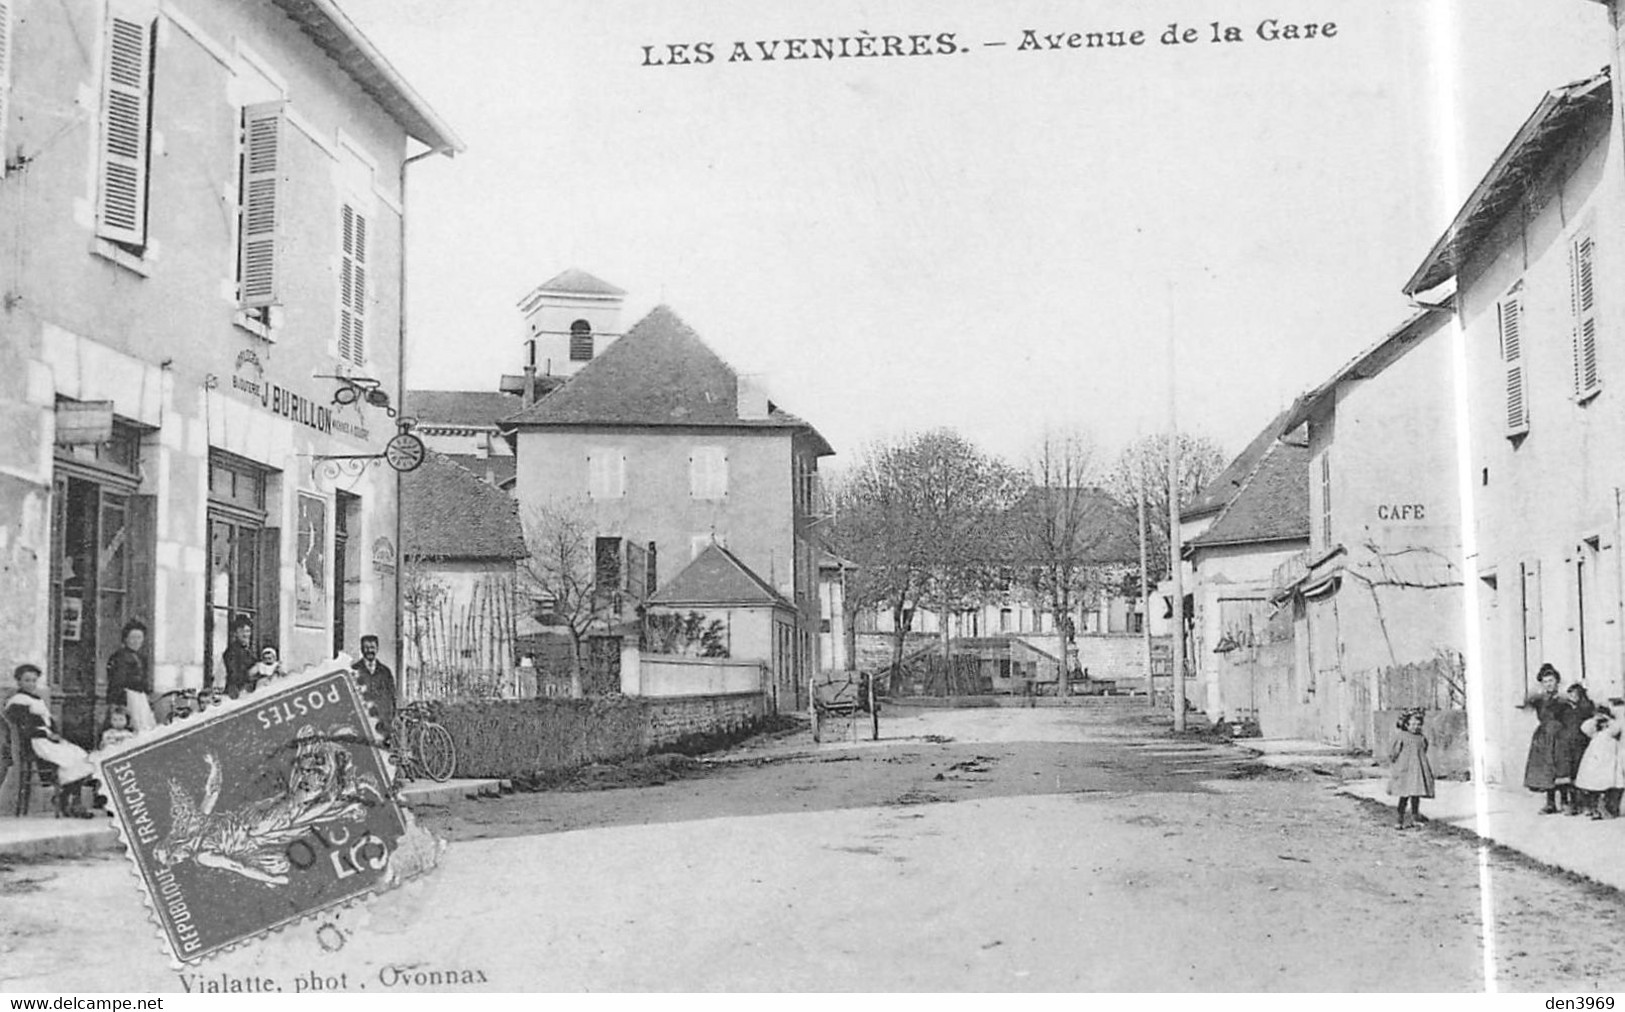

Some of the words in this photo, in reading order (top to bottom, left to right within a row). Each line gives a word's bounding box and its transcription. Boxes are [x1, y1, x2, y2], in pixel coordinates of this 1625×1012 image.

[272, 385, 333, 435] BURILLON
[1378, 504, 1425, 520] CAFE
[257, 684, 341, 729] POSTES
